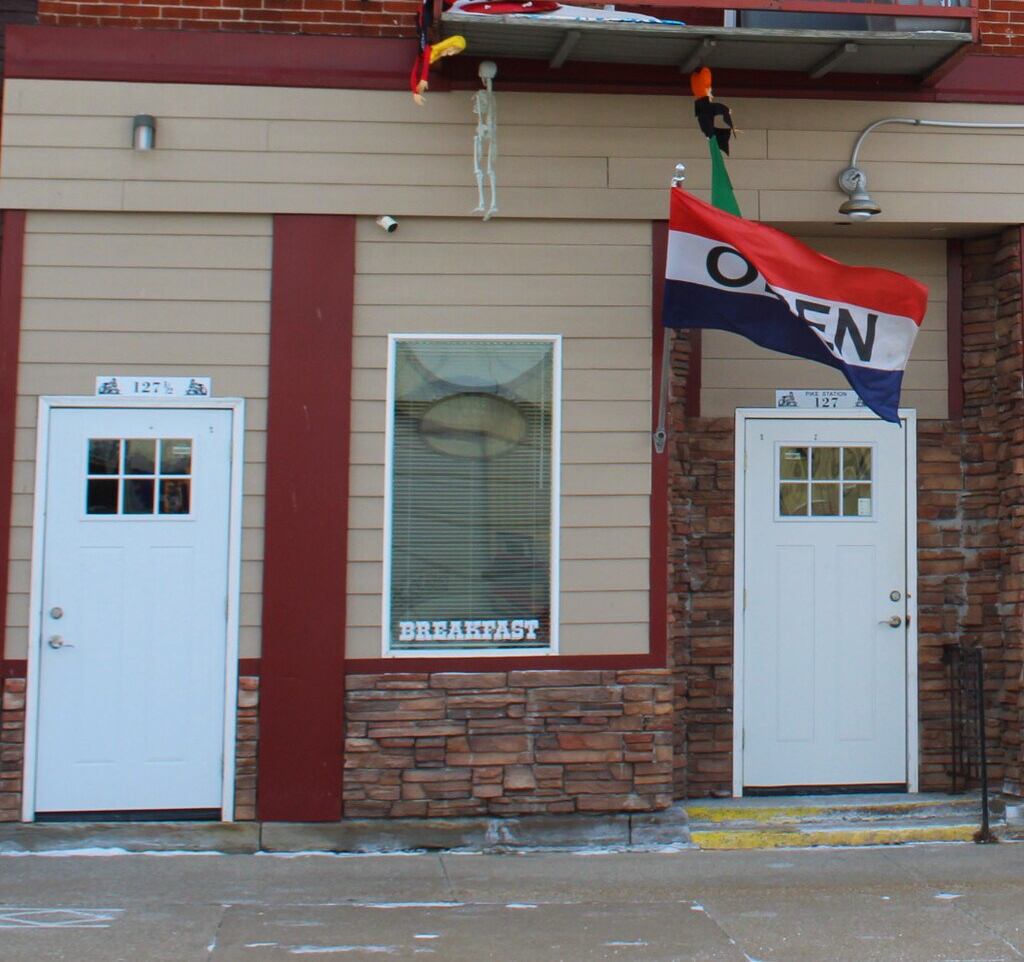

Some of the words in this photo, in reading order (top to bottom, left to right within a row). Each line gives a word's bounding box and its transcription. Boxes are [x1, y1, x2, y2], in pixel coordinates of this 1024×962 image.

[706, 245, 878, 363] OEN
[133, 381, 161, 394] 127
[814, 397, 839, 408] 127
[399, 620, 539, 641] BREAKFAST
